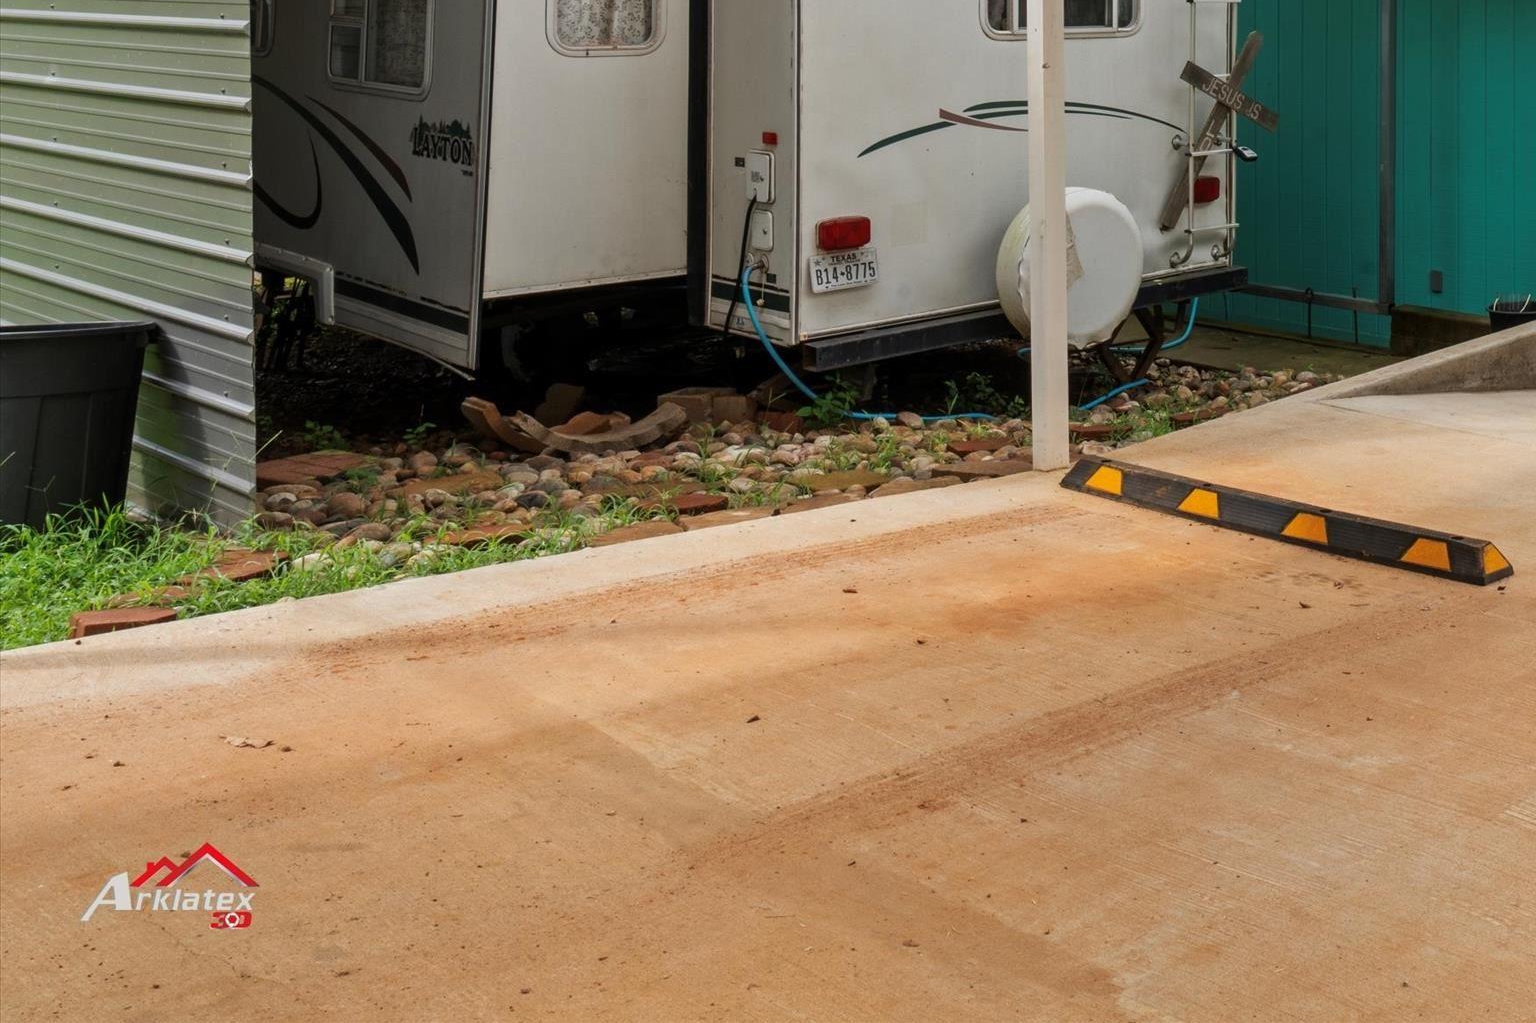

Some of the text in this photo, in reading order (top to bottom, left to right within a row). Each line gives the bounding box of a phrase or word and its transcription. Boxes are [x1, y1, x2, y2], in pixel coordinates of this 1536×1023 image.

[1202, 78, 1245, 111] JESUS
[412, 126, 472, 166] LAYTON
[830, 253, 857, 262] TEXAS
